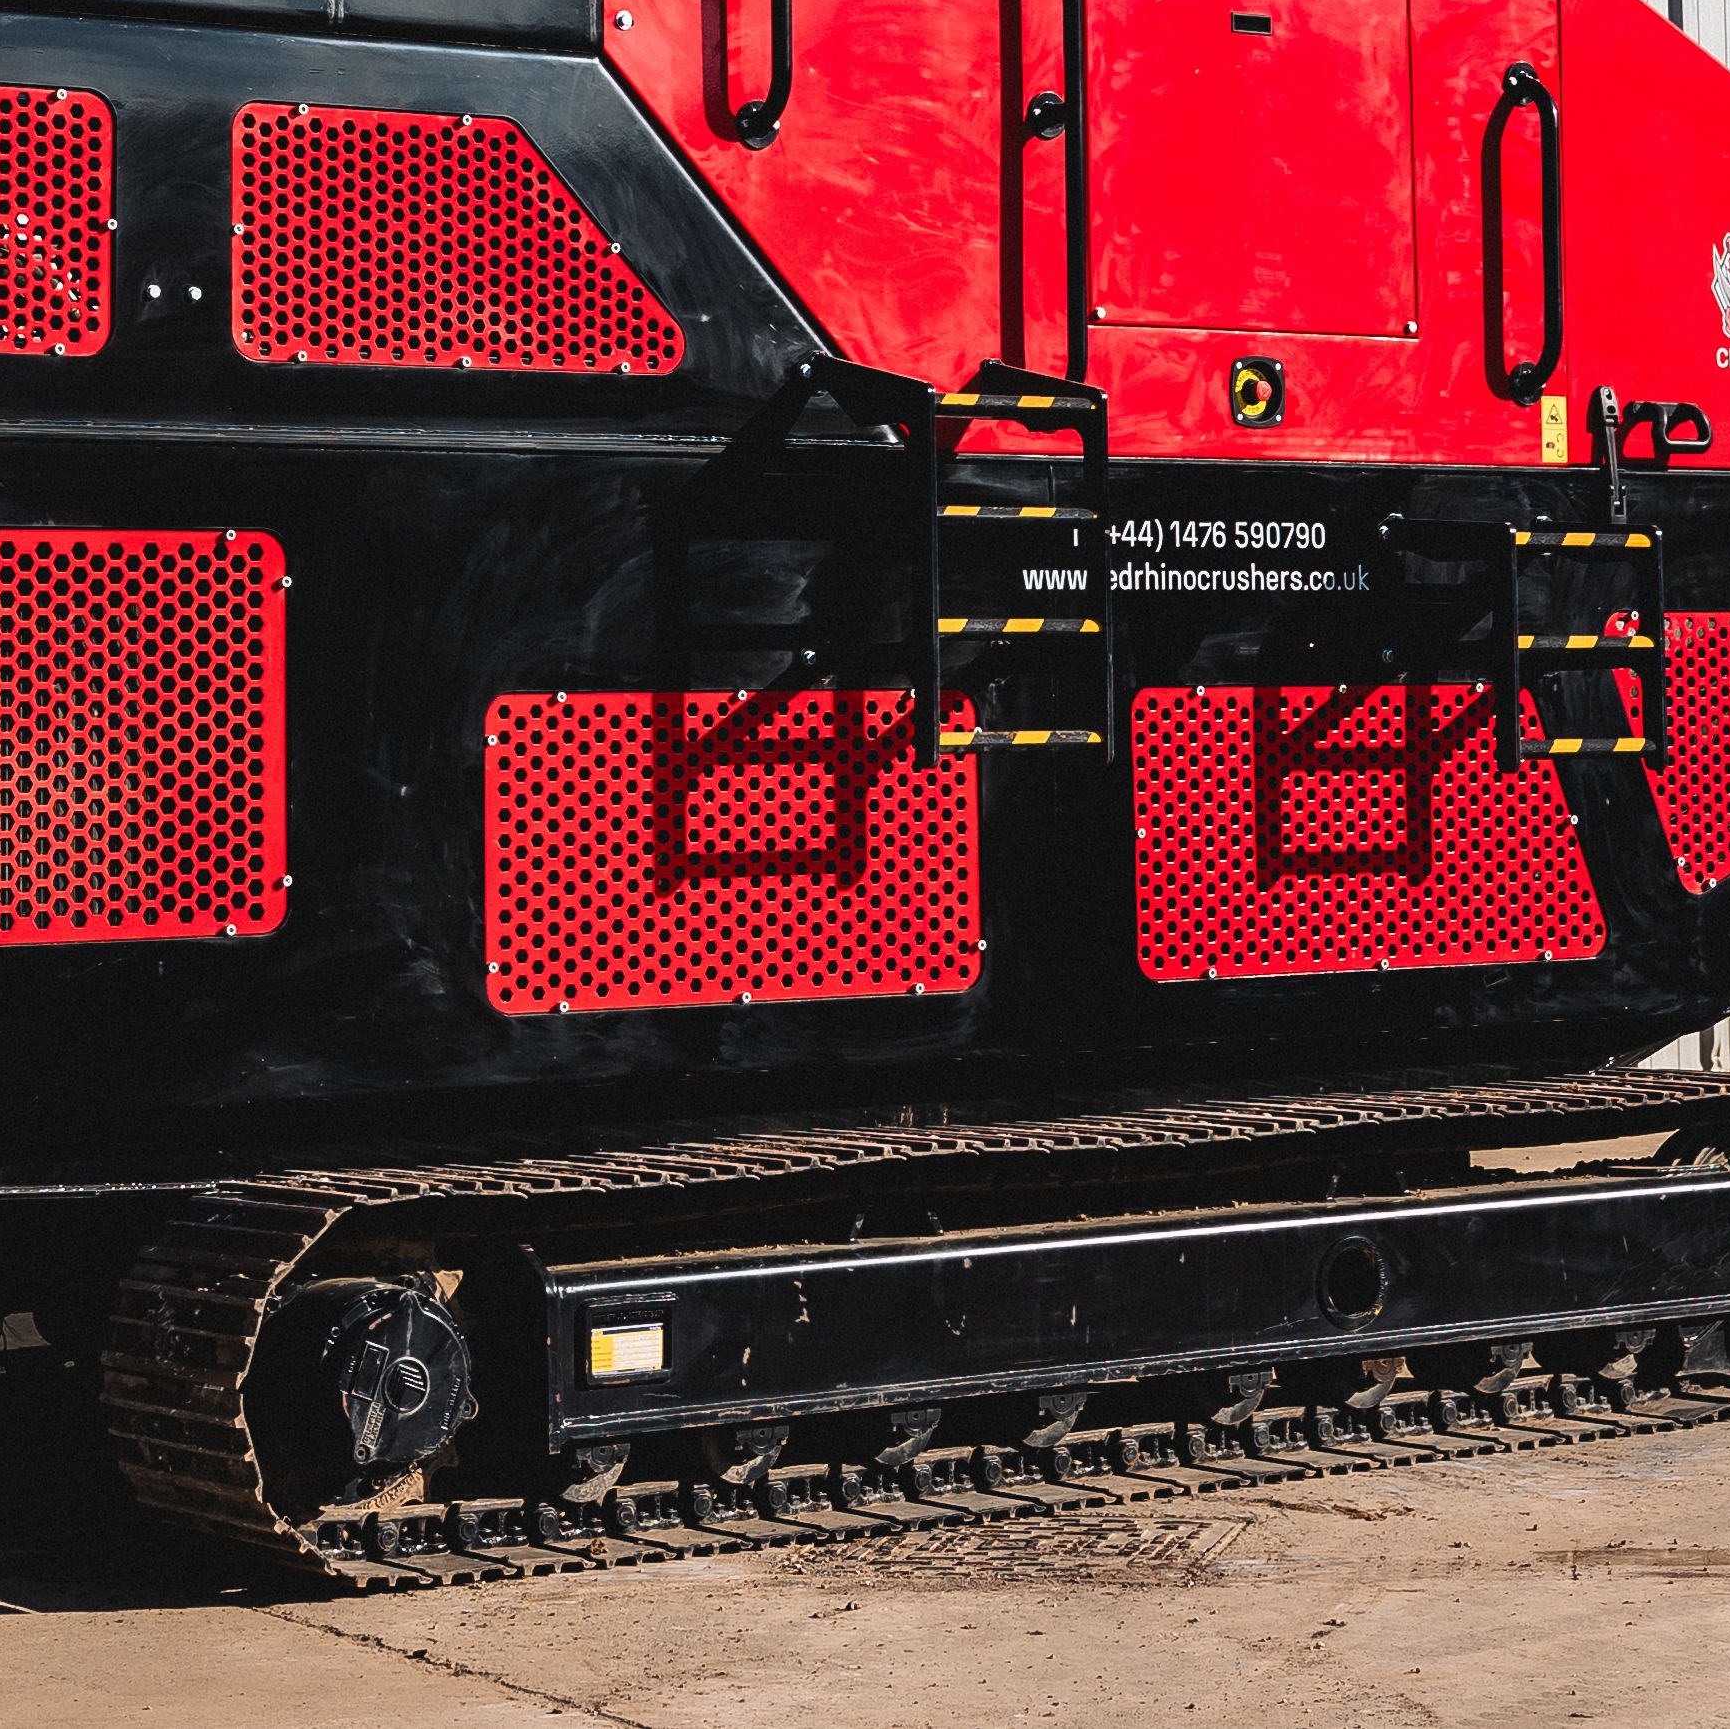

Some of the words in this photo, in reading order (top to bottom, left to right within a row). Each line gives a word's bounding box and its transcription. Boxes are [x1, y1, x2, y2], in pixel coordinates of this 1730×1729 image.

[1105, 518, 1164, 553] +44)
[1169, 520, 1227, 549] 1476
[1234, 521, 1326, 550] 590790
[1022, 561, 1370, 592] wwwedrhinocrushers.co.uk
